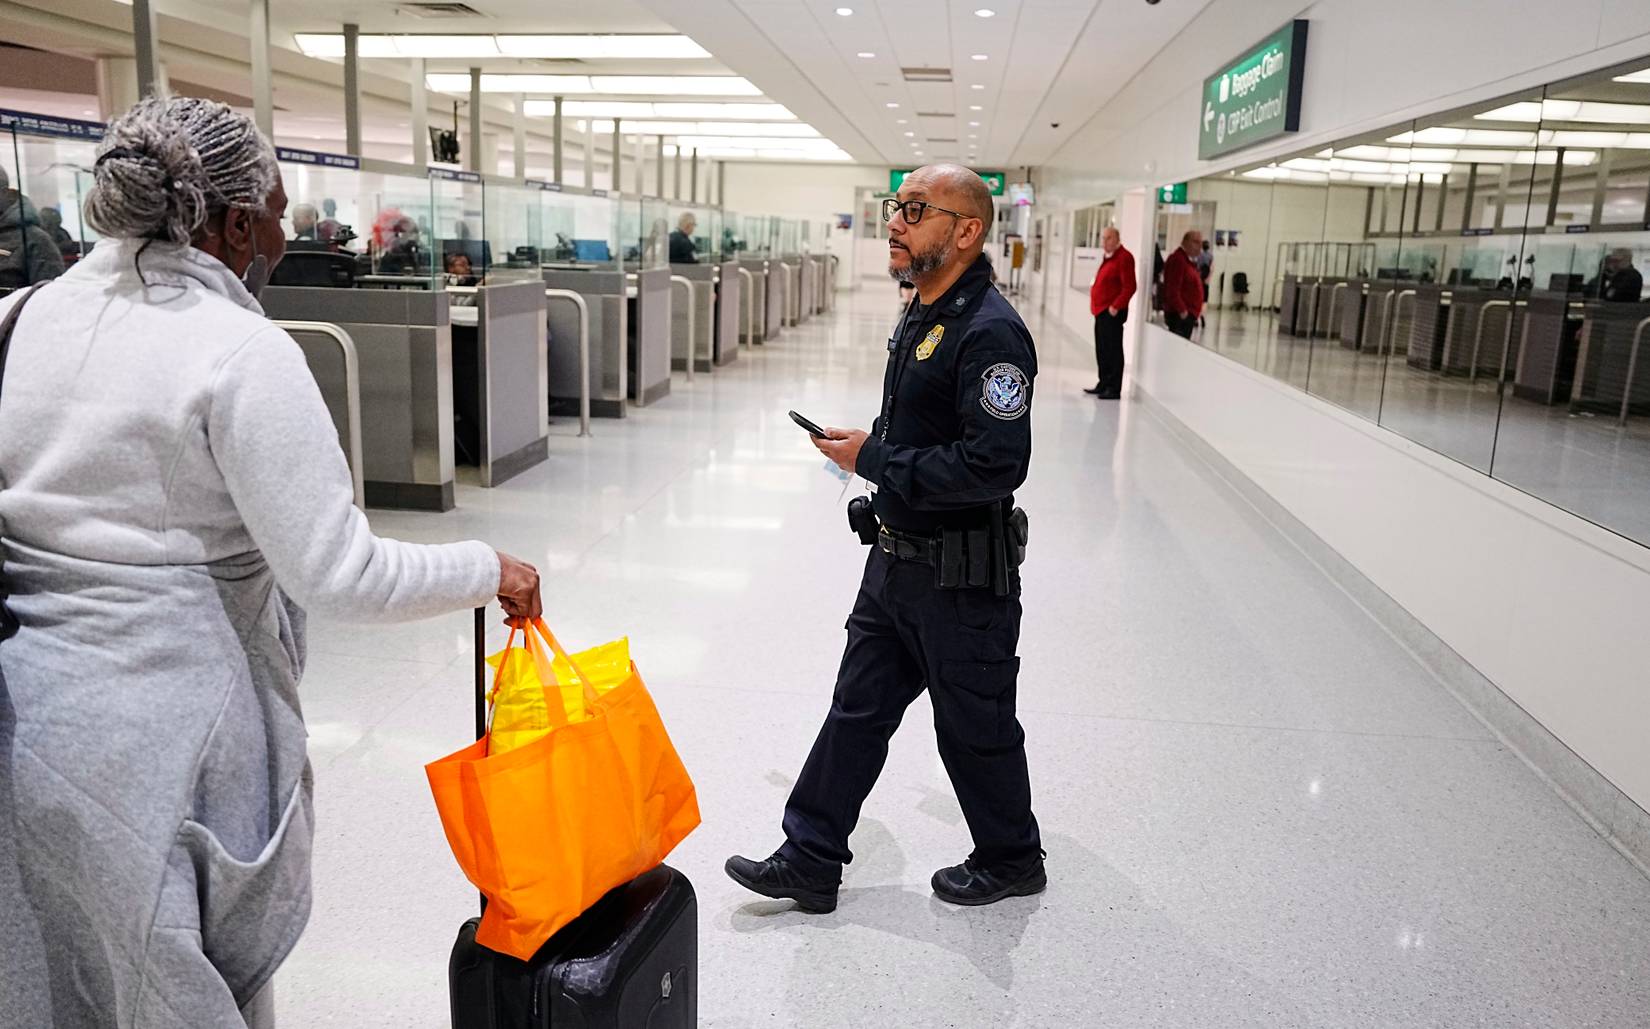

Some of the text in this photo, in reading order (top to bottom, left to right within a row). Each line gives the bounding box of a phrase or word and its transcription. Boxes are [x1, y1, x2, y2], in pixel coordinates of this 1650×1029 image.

[1232, 48, 1284, 97] Baggage Claim
[1227, 88, 1283, 135] CBP Exit Control
